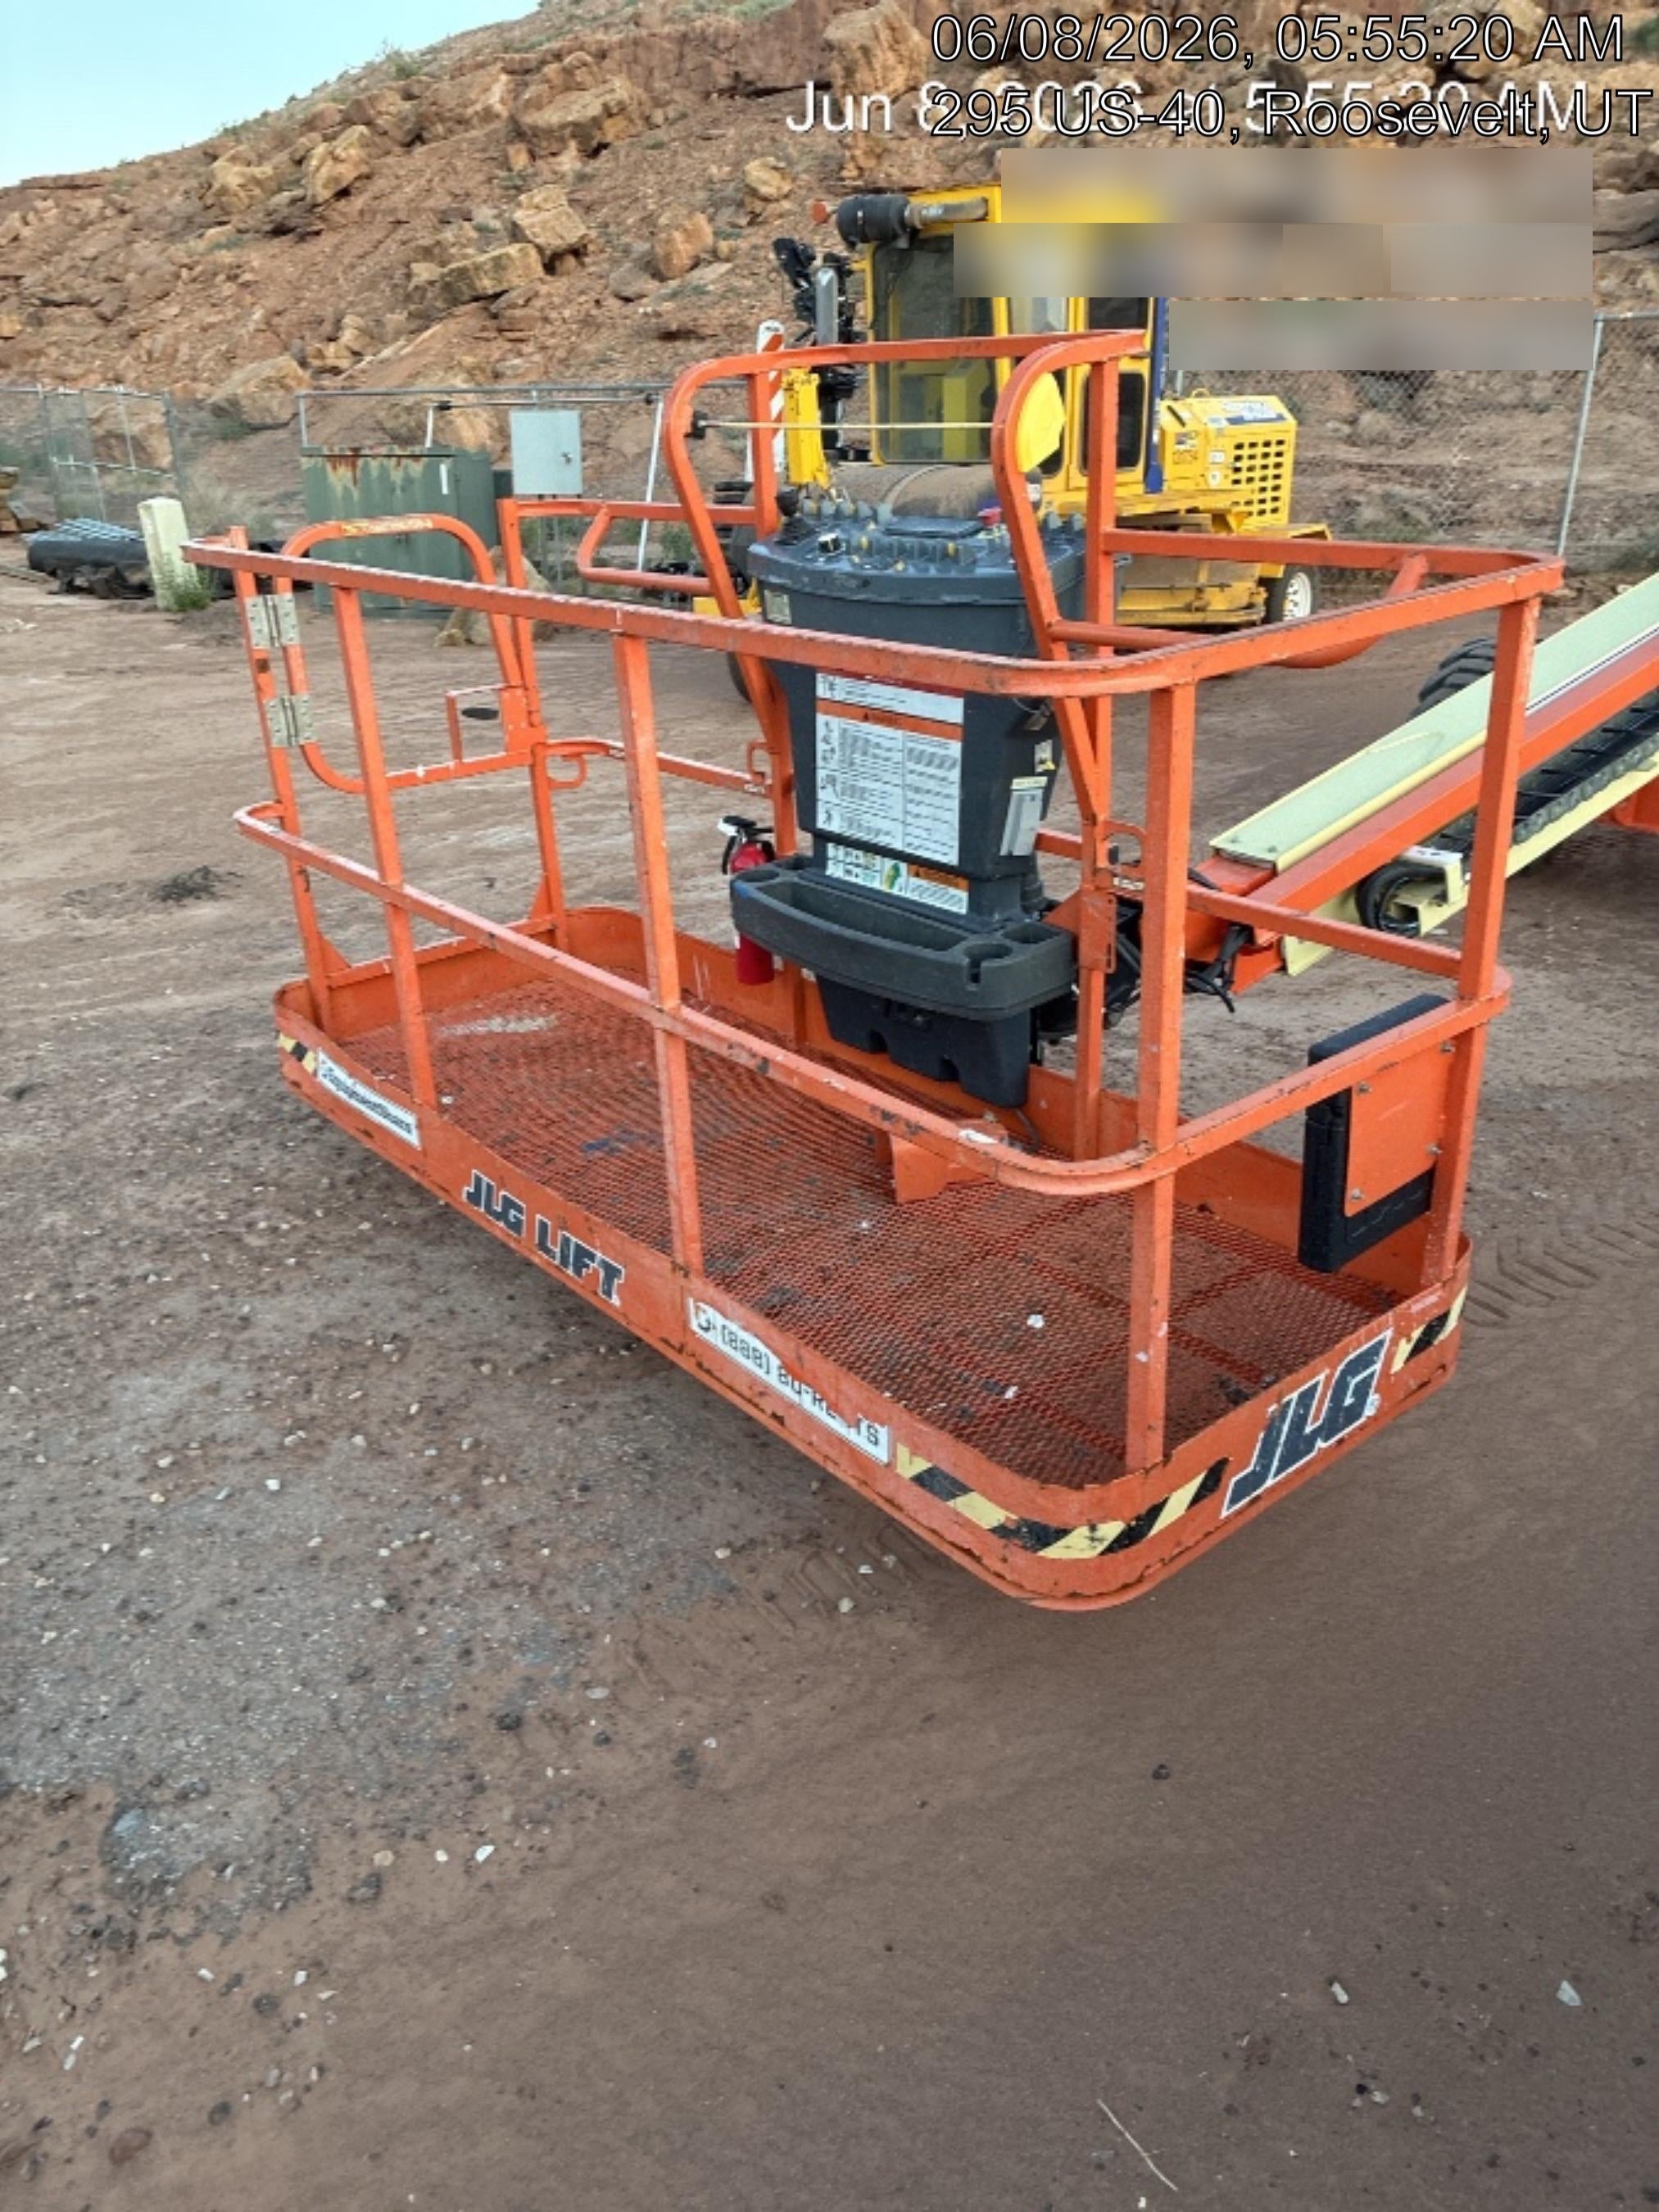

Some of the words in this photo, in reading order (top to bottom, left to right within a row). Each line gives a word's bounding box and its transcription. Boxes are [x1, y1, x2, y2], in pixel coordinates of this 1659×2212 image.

[463, 1169, 526, 1238] JLG
[535, 1213, 625, 1308] LIFT
[1220, 1327, 1394, 1520] JLG
